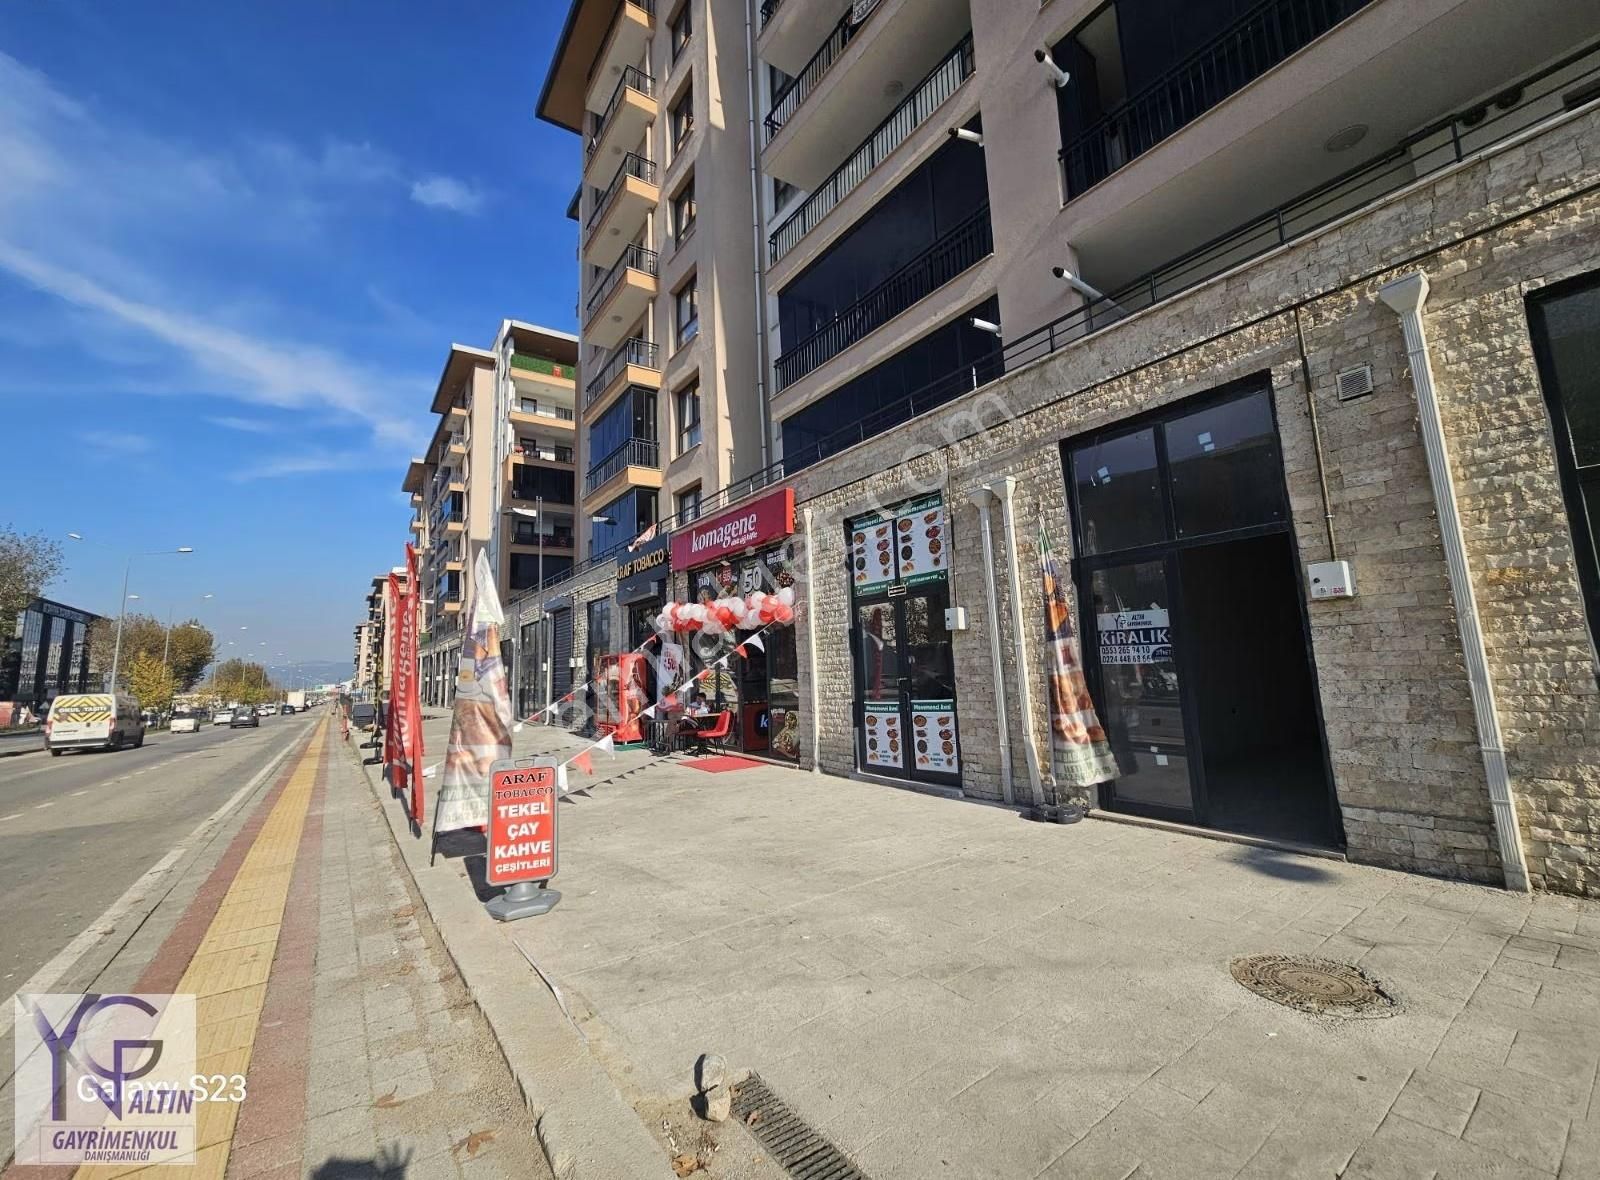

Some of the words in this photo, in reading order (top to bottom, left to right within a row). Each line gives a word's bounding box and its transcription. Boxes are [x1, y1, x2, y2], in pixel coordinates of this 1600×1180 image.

[691, 513, 757, 552] komagene
[616, 561, 632, 580] ARAF
[633, 548, 665, 574] TOBACCO
[742, 566, 762, 593] 50
[1102, 655, 1118, 664] 0224
[502, 772, 547, 786] ARAF
[495, 786, 554, 800] TOBACCO
[497, 801, 551, 819] TEKEL
[507, 821, 540, 841] ÇAY
[494, 840, 552, 860] KAHVE
[495, 857, 551, 874] ÇEŞİTLERİ
